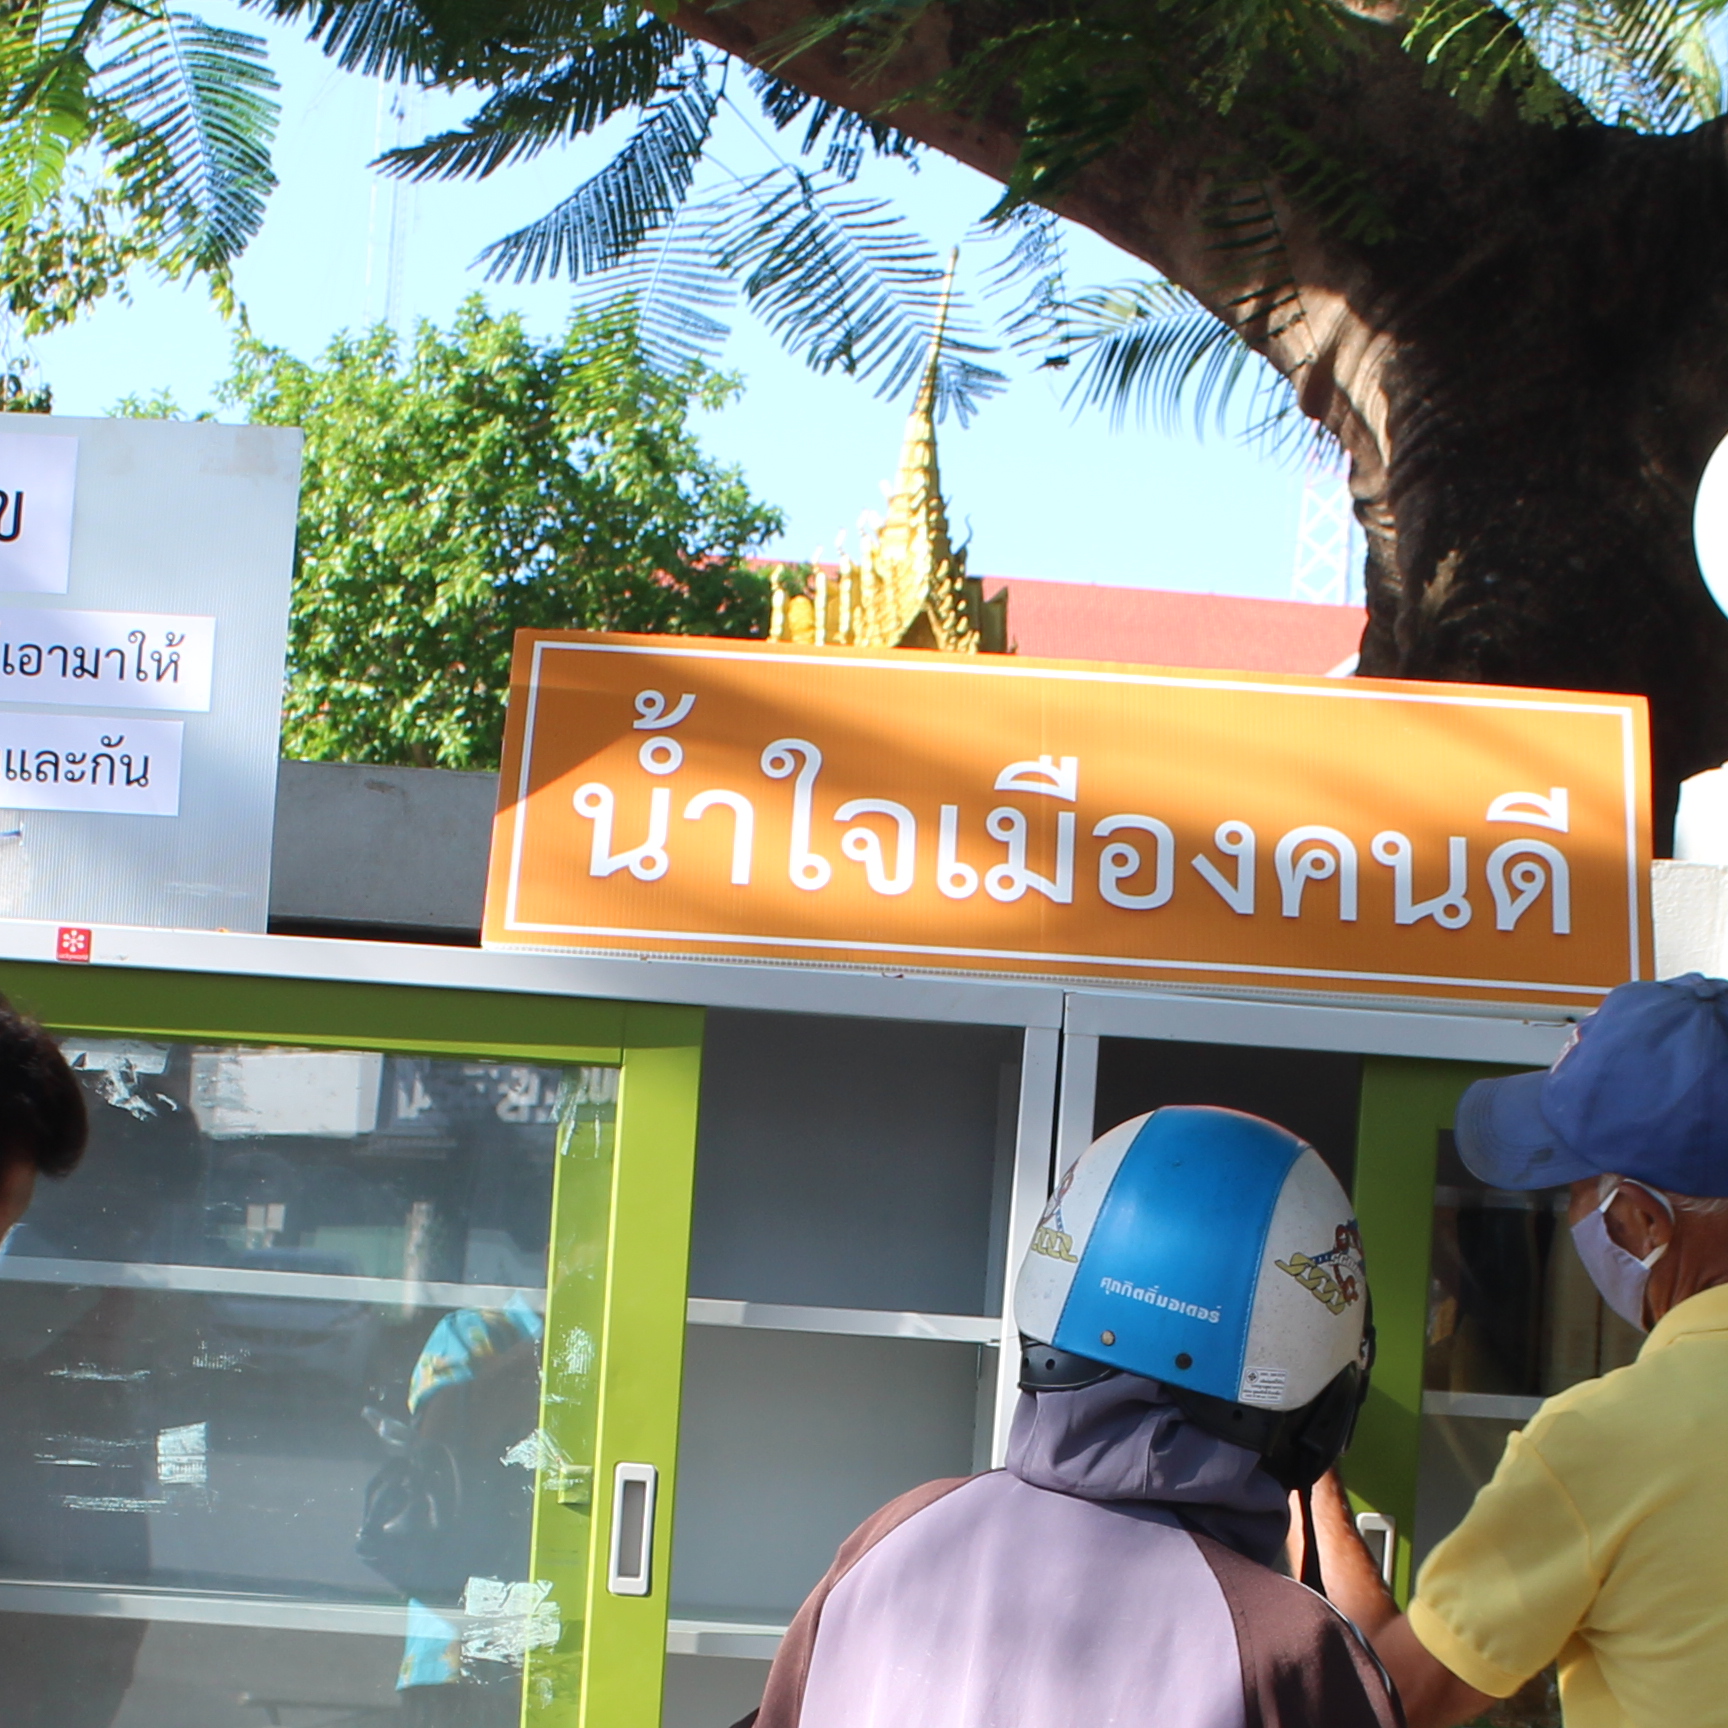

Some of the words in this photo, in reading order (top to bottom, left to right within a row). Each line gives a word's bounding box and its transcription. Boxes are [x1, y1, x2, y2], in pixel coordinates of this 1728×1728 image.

[572, 688, 1573, 937] น้ำใจเมืองคนดี
